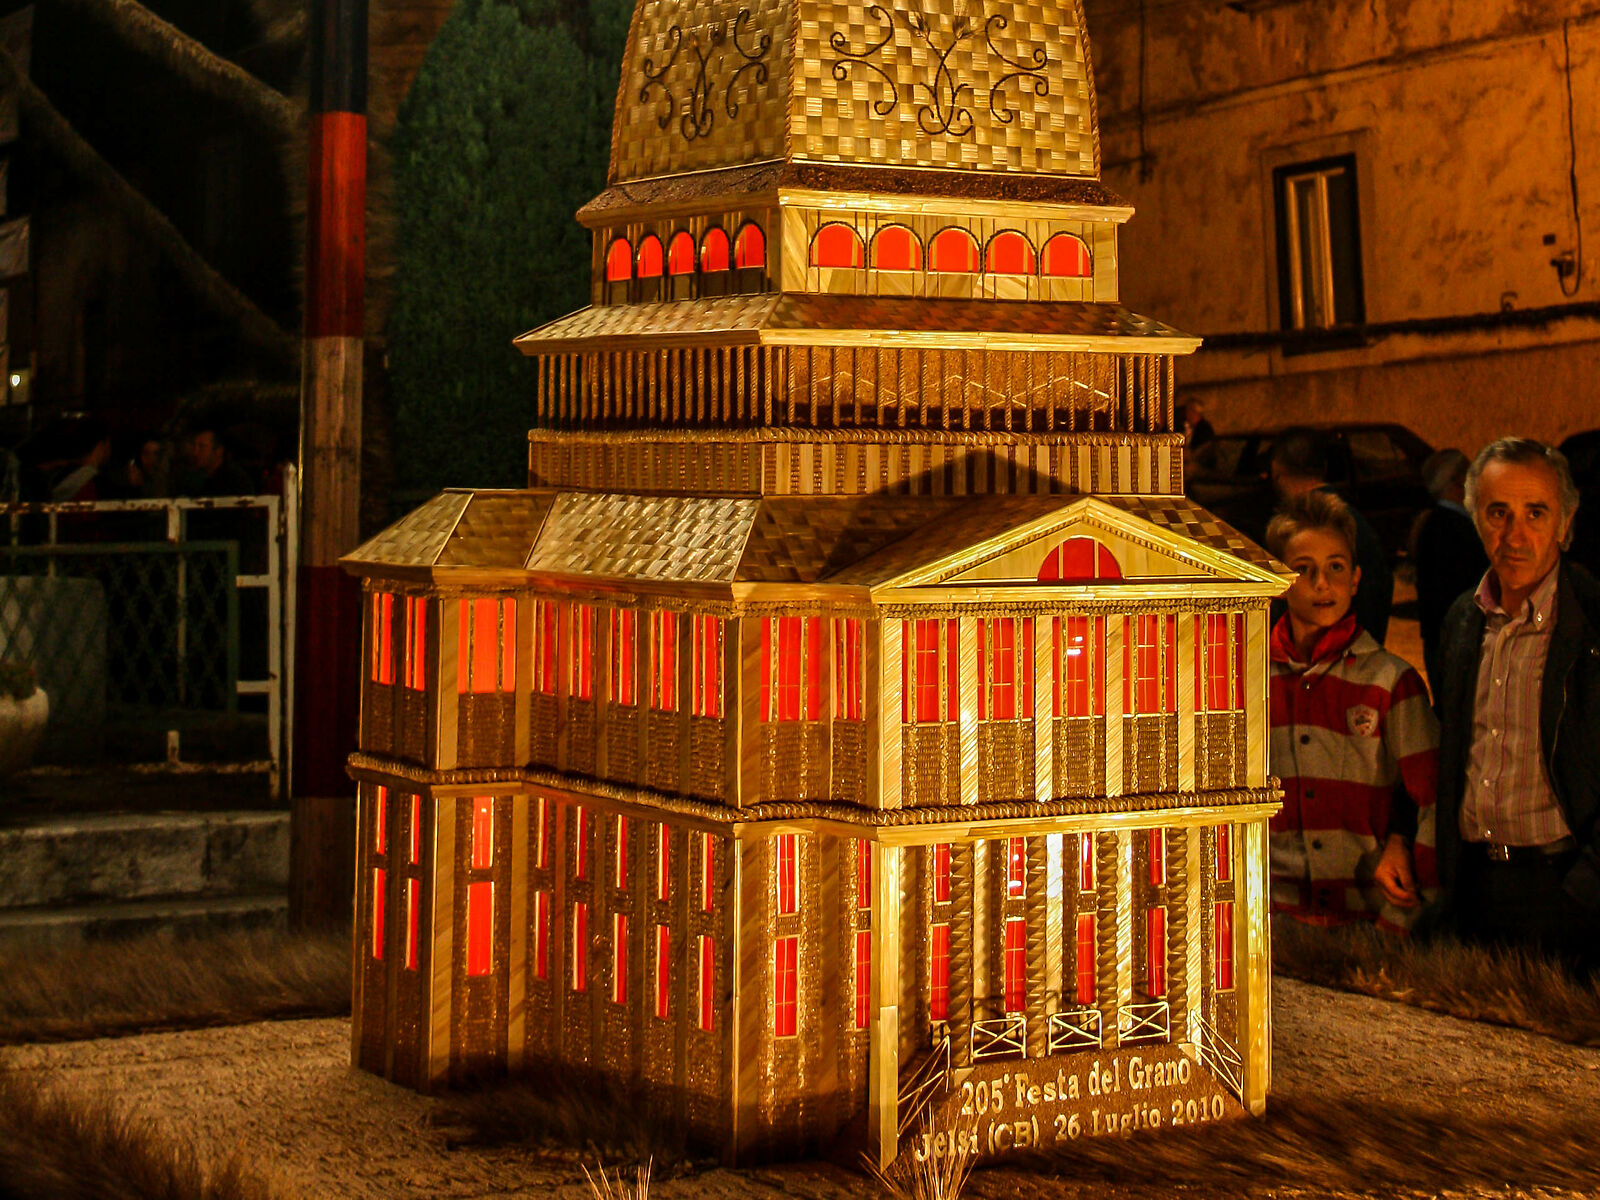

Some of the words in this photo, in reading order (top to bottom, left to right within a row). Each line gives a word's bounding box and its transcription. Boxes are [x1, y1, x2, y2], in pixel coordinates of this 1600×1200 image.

[1015, 1070, 1079, 1107] Festa
[1088, 1057, 1121, 1096] del
[1128, 1056, 1191, 1090] Grano
[914, 1125, 979, 1161] Jelsi
[988, 1114, 1040, 1155] (CB)
[1054, 1112, 1081, 1141] 26
[1091, 1101, 1161, 1140] Luglio
[1172, 1094, 1225, 1127] 2010
